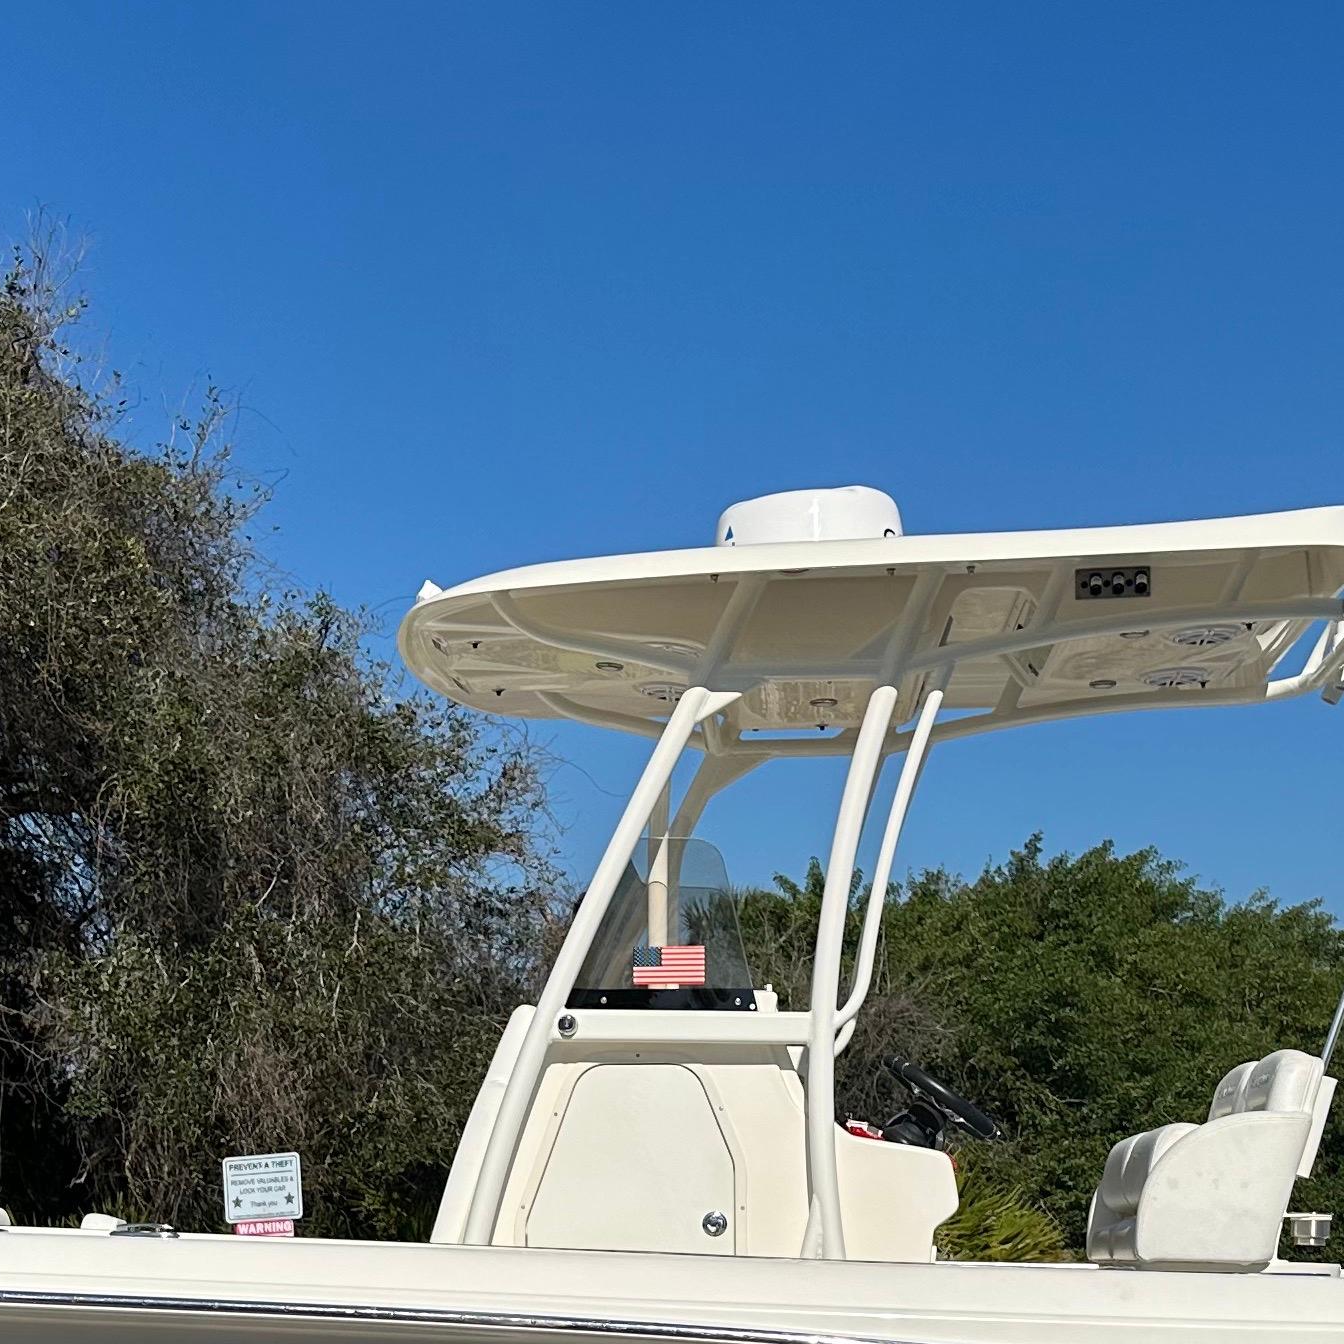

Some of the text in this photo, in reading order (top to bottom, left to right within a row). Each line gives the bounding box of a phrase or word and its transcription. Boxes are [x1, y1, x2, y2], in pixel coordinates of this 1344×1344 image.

[228, 1162, 263, 1171] PREVENT
[272, 1160, 293, 1168] THEFT
[231, 1178, 255, 1186] REMOVE
[237, 1221, 293, 1235] WARNING
